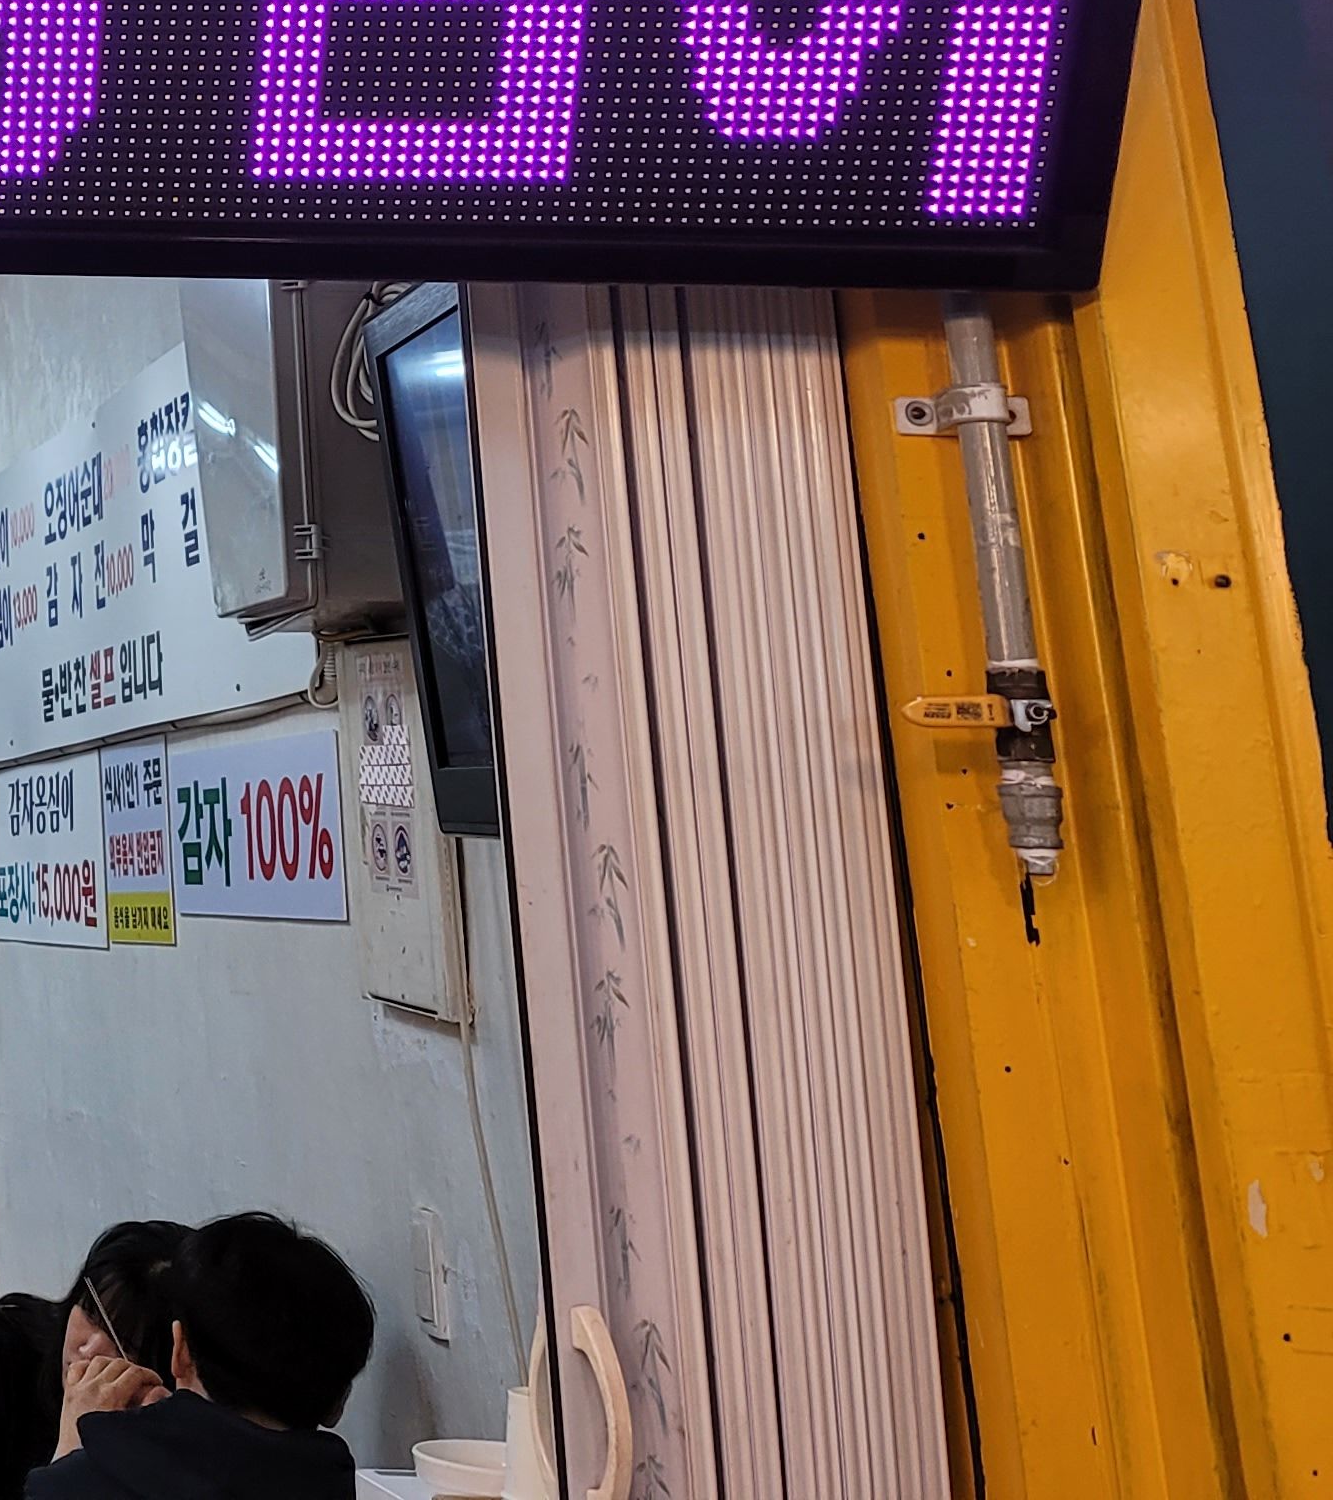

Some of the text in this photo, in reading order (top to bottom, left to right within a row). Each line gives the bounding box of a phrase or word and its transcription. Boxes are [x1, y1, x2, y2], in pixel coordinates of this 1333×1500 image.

[44, 451, 104, 546] 오징어순대
[105, 543, 134, 599] 10,000
[8, 768, 74, 838] 감자옹심이
[143, 757, 162, 807] 주문
[177, 772, 333, 886] 감자 100%
